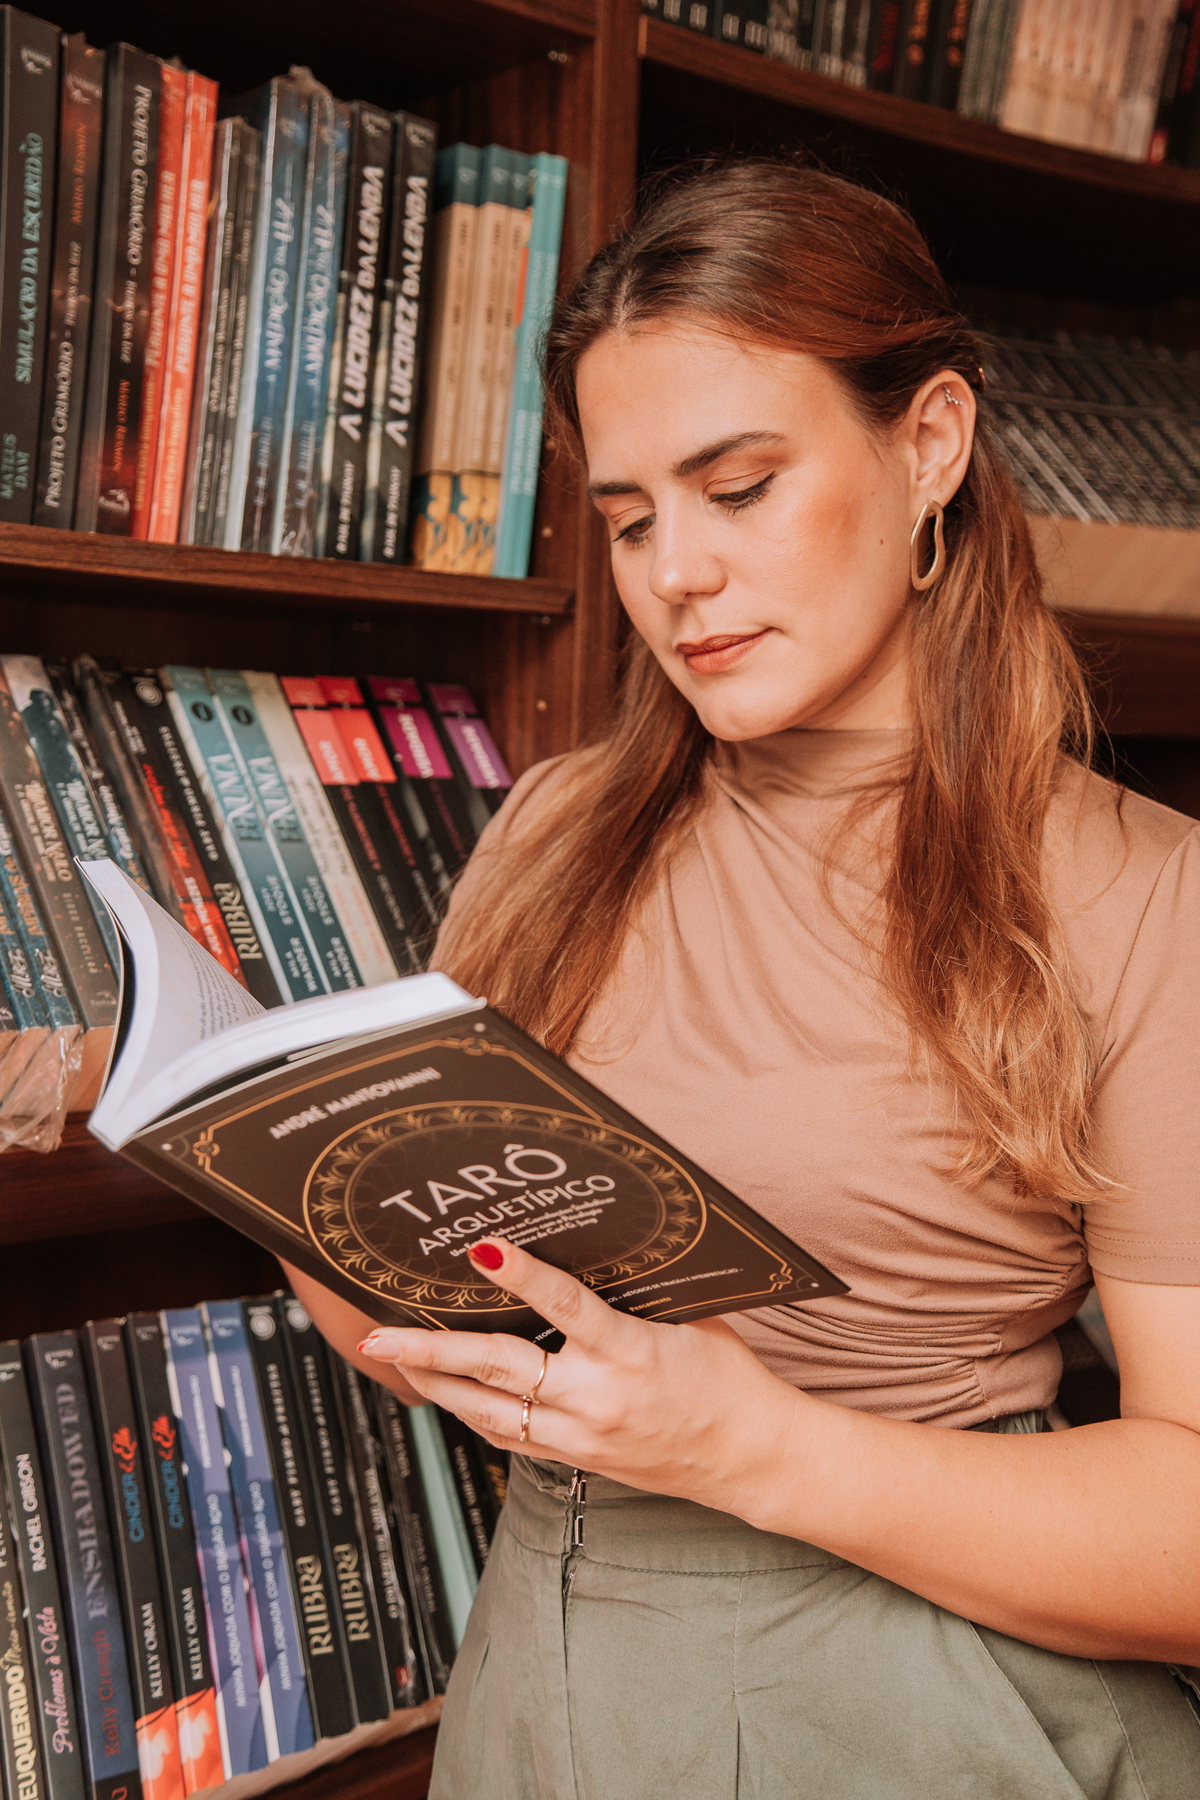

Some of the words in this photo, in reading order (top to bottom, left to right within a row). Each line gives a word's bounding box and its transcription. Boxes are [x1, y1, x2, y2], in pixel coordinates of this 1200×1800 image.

[131, 84, 152, 166] PROJETO
[19, 132, 43, 242] ESCURIDÃO
[126, 168, 148, 265] GRIMÓRIO
[21, 247, 38, 275] DA
[15, 276, 38, 384] SIMULACRO
[342, 286, 374, 409] LUCIDEZ
[388, 294, 419, 415] LUCIDEZ
[52, 341, 74, 433] GRIMÓRIO
[45, 436, 65, 507] PROJETO
[159, 725, 186, 776] FREITAS
[318, 739, 346, 784] AMOR
[353, 737, 381, 781] AMOR
[398, 713, 434, 778] VERDADE
[460, 725, 499, 789] VERDADE
[200, 829, 219, 861] GABY
[184, 876, 211, 930] MENEZES
[213, 882, 264, 959] RUBRA
[261, 887, 276, 913] JOSY
[266, 874, 293, 926] STOQUE
[306, 875, 334, 926] STOQUE
[285, 951, 300, 978] MILA
[290, 937, 318, 992] WANDER
[326, 950, 342, 977] MILA
[268, 1104, 329, 1139] ANDRÉ
[325, 1066, 442, 1115] MANTOVANNI
[379, 1143, 567, 1223] TARÔ
[418, 1174, 616, 1256] ARQUETÍPICO
[546, 1224, 567, 1235] Carl
[575, 1217, 599, 1228] Jung
[622, 1285, 653, 1298] MÉTODOS
[651, 1281, 662, 1290] DE
[690, 1267, 739, 1281] INTERPRETAÇÃO
[628, 1296, 672, 1312] Pensamento
[267, 1363, 288, 1423] FREITAS
[304, 1355, 322, 1414] FREITAS
[112, 1425, 137, 1460] Ella
[152, 1414, 176, 1448] Ella
[16, 1453, 38, 1512] GIBSON
[281, 1437, 298, 1485] FIRMO
[55, 1383, 108, 1621] ENSHADOWED
[121, 1472, 144, 1542] CINDER
[161, 1460, 183, 1528] CINDER
[206, 1493, 222, 1525] ROXO
[249, 1481, 265, 1513] ROXO
[291, 1488, 306, 1527] GABY
[327, 1476, 343, 1516] GABY
[24, 1513, 47, 1572] RACHEL
[211, 1524, 228, 1571] DRAGÃO
[254, 1512, 272, 1557] DRAGÃO
[218, 1571, 230, 1583] O
[262, 1558, 274, 1569] O
[264, 1570, 279, 1600] COM
[181, 1587, 197, 1635] ORAM
[219, 1584, 234, 1614] COM
[296, 1555, 334, 1656] RUBRA
[334, 1543, 371, 1641] RUBRA
[36, 1606, 57, 1655] Vista
[142, 1602, 158, 1650] ORAM
[225, 1615, 244, 1669] JORNADA
[269, 1600, 288, 1652] JORNADA
[45, 1651, 61, 1665] à
[92, 1629, 114, 1701] Creagh
[145, 1649, 163, 1699] KELLY
[188, 1636, 203, 1681] KELLY
[279, 1650, 292, 1690] MINHA
[44, 1667, 73, 1754] Problemas
[232, 1669, 246, 1706] MINHA
[5, 1665, 36, 1770] QUERIDO
[105, 1707, 120, 1757] Kelly
